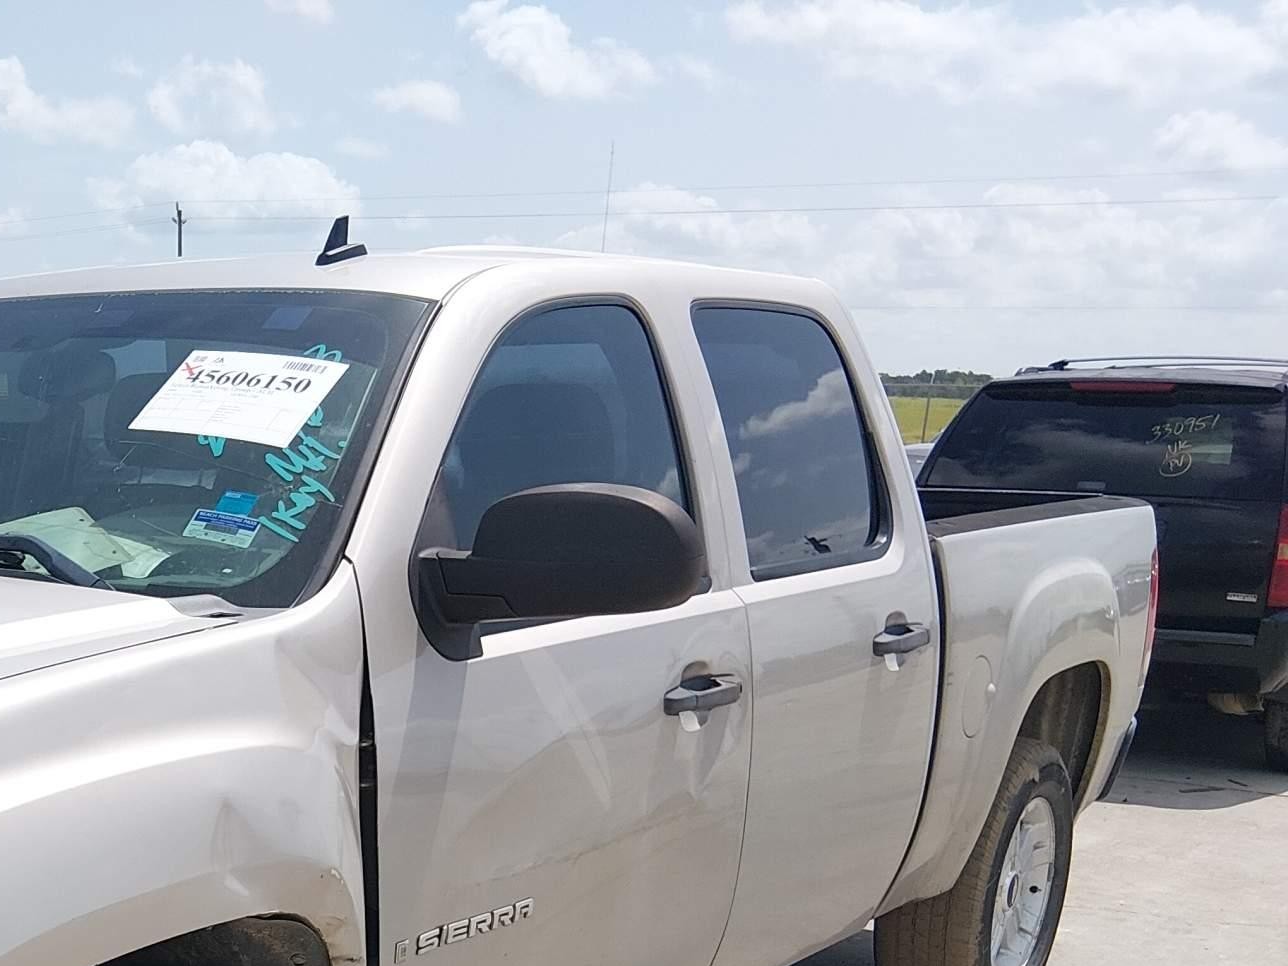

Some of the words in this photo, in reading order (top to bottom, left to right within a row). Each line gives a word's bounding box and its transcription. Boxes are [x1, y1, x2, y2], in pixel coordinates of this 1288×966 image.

[186, 369, 312, 393] 45606150
[1150, 413, 1221, 442] 330951
[416, 897, 534, 956] SIERRA
